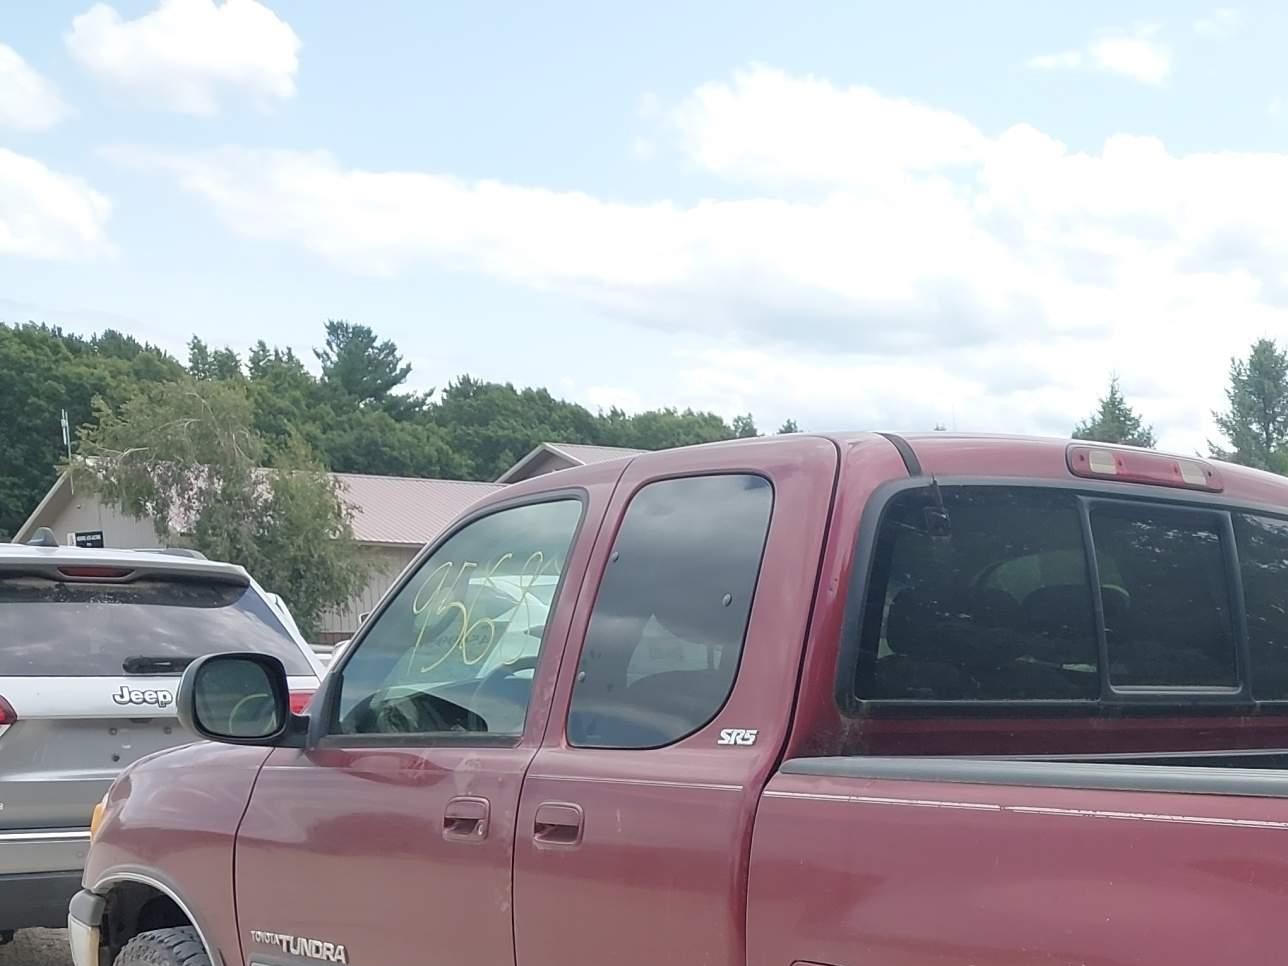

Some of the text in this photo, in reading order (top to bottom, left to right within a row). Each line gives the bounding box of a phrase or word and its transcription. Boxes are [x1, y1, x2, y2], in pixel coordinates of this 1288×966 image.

[112, 685, 174, 708] Jeep
[717, 728, 758, 746] SR5
[250, 930, 348, 965] TOYOTA TUNDRA
